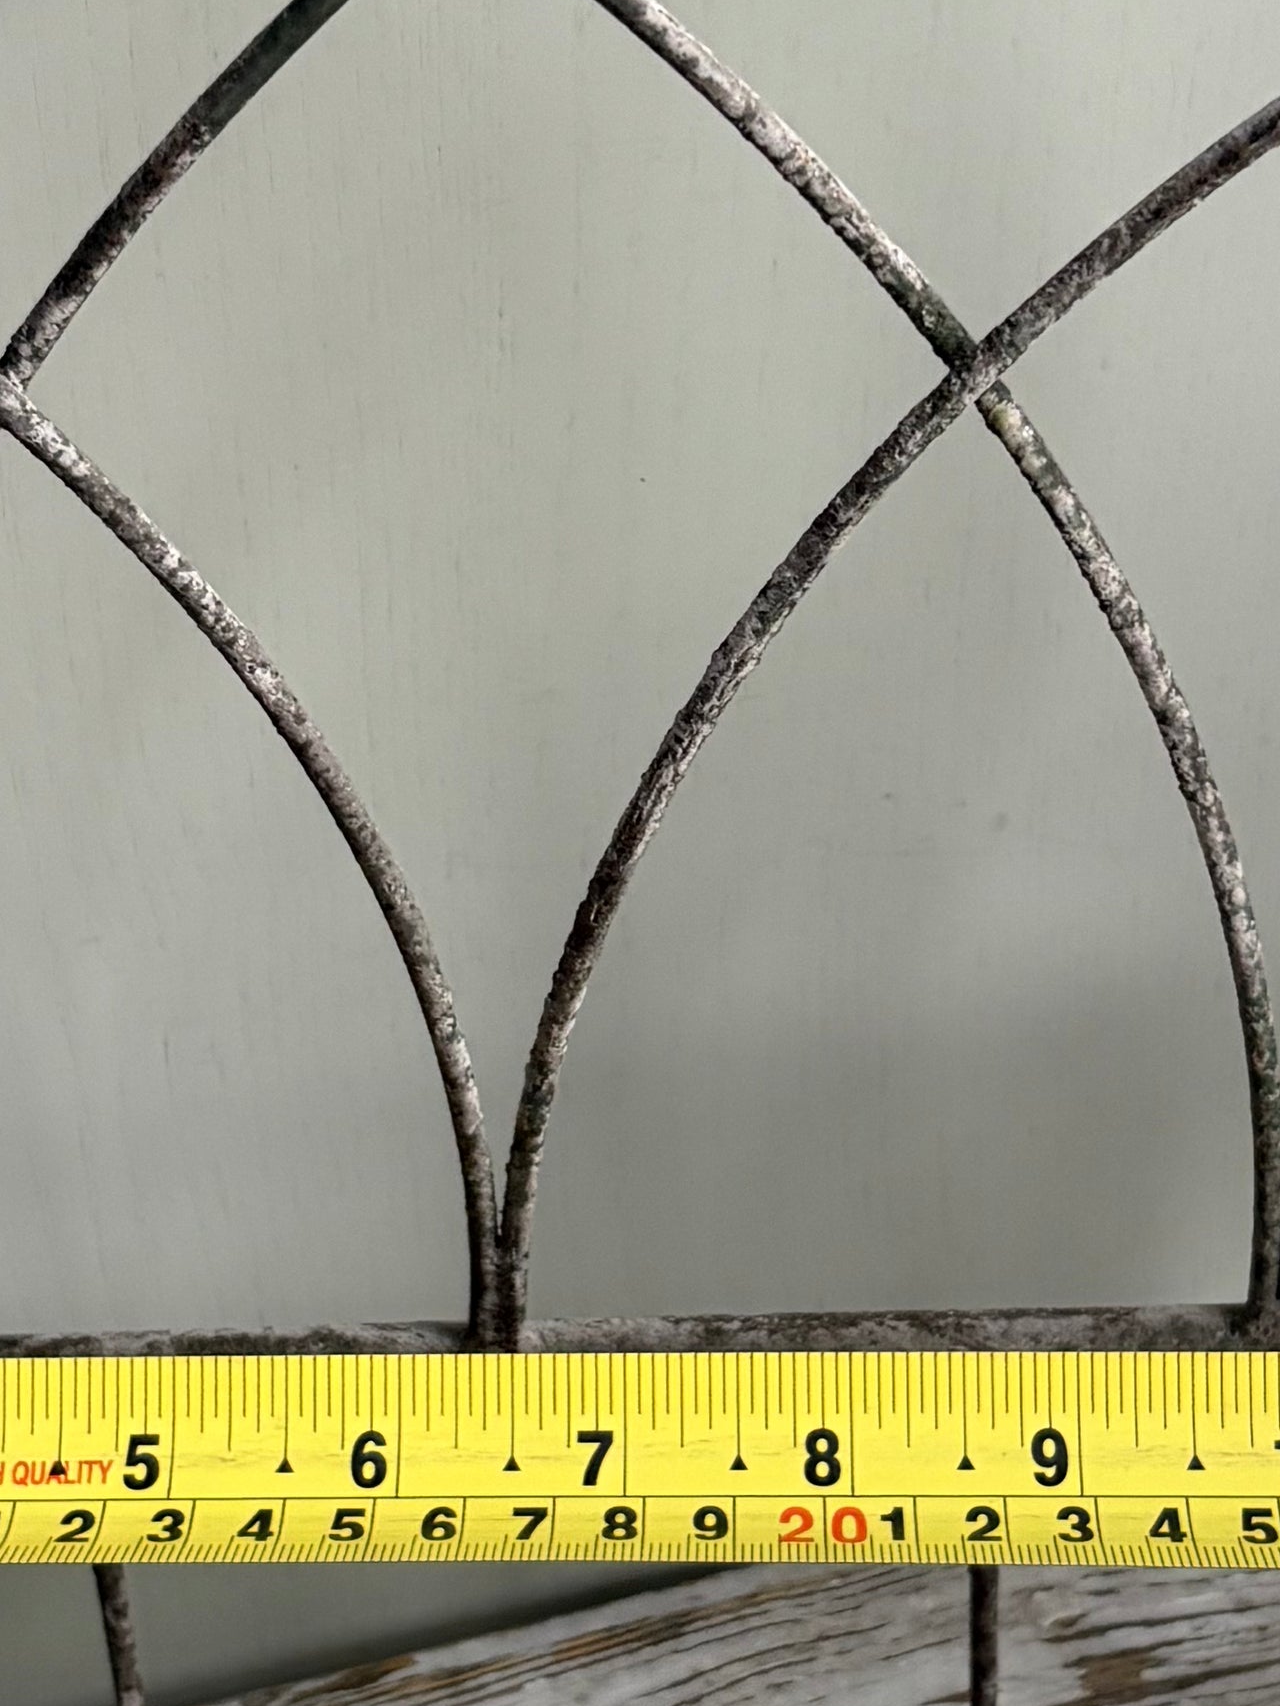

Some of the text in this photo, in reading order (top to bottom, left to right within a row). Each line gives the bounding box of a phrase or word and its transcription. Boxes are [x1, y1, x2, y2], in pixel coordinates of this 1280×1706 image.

[11, 1459, 114, 1485] QUALITY
[122, 1434, 160, 1490] 5
[350, 1430, 387, 1489] 6
[576, 1431, 613, 1486] 7
[804, 1428, 841, 1486] 8
[1031, 1428, 1069, 1486] 9
[53, 1511, 95, 1543] 2
[146, 1510, 185, 1542] 3
[236, 1509, 274, 1541] 4
[328, 1509, 366, 1541] 5
[420, 1506, 457, 1541] 6
[512, 1507, 548, 1540] 7
[601, 1506, 638, 1540] 8
[692, 1506, 729, 1540] 9
[779, 1506, 867, 1543] 20
[880, 1506, 906, 1541] 1
[966, 1506, 1001, 1542] 2
[1056, 1506, 1094, 1543] 3
[1149, 1507, 1187, 1543] 4
[1241, 1509, 1279, 1544] 5
